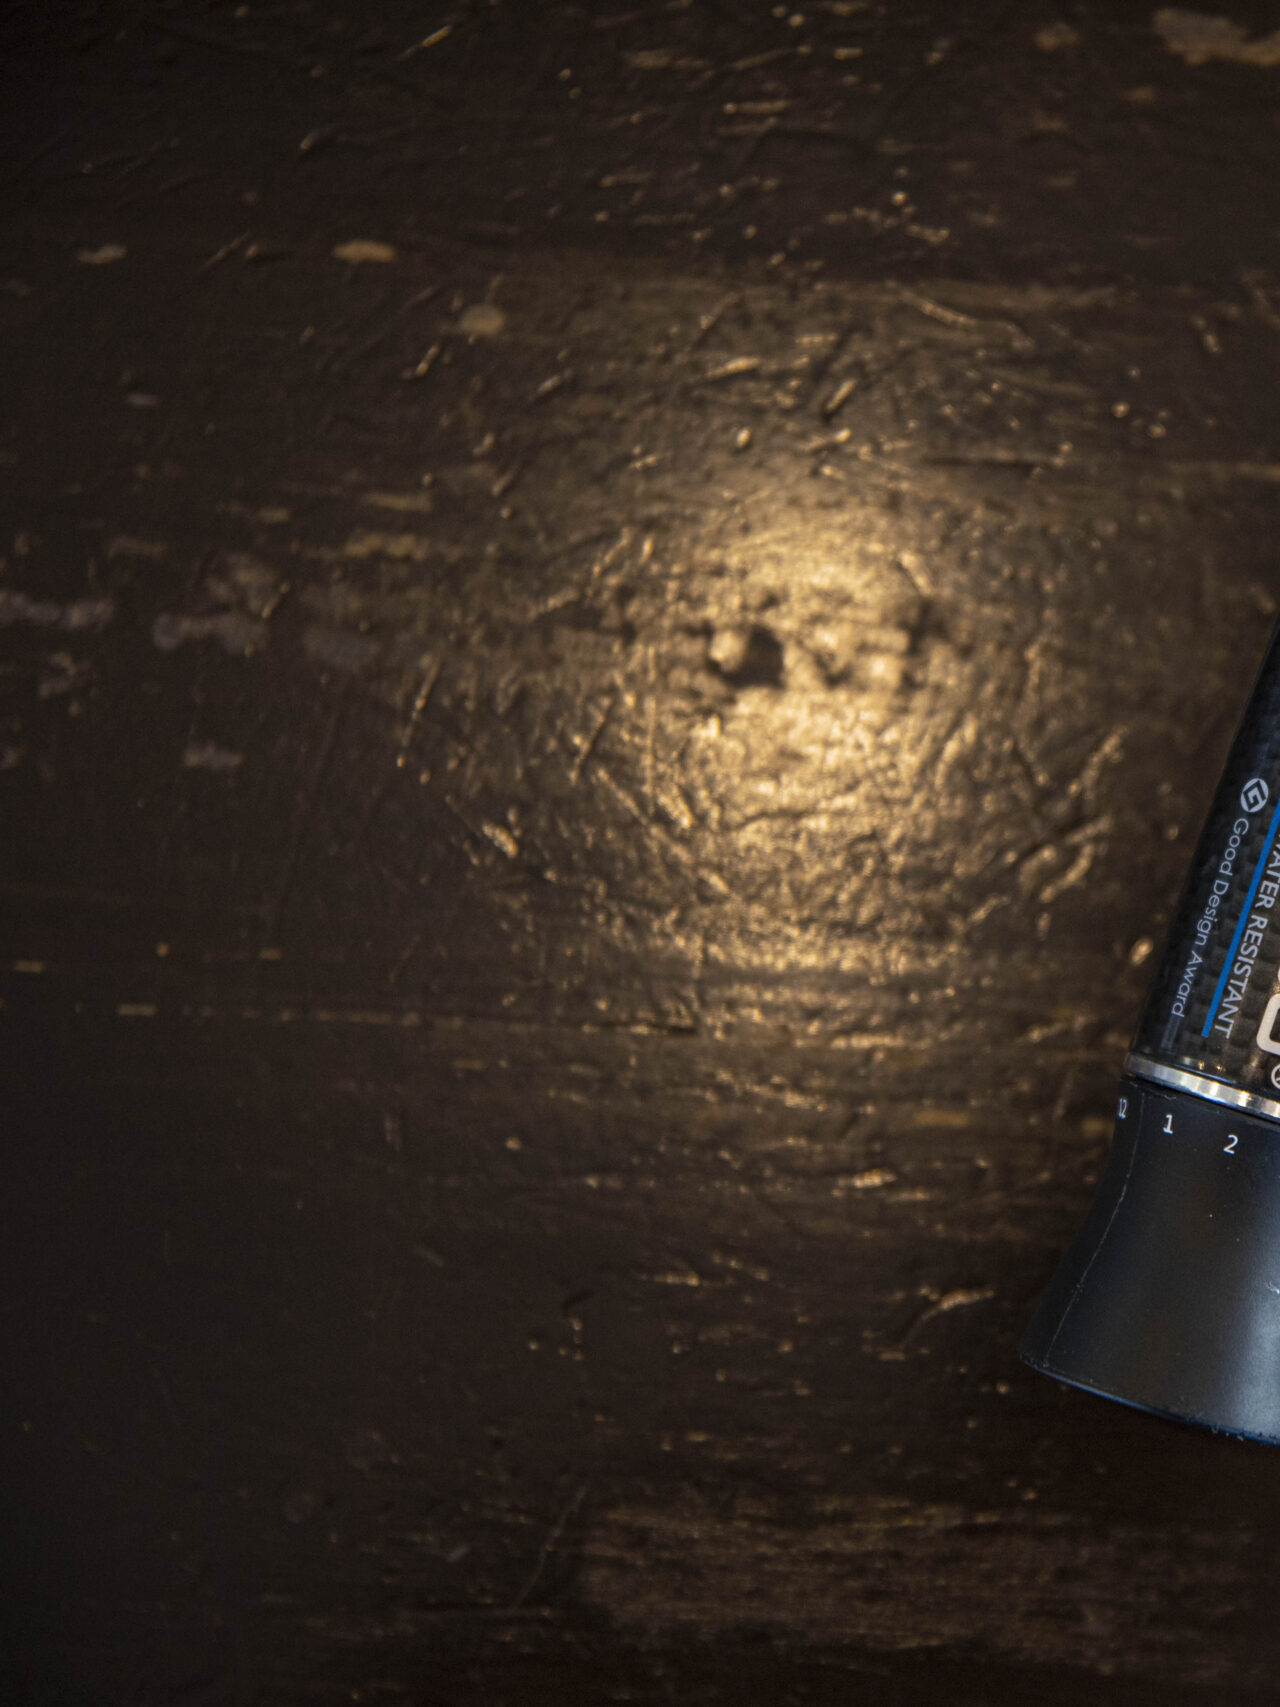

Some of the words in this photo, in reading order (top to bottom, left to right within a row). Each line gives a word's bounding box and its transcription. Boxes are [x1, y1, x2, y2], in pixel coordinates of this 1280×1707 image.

[1219, 818, 1249, 876] Good
[1195, 881, 1229, 946] Design
[1171, 951, 1203, 1017] Award
[1214, 914, 1268, 1039] RESISTANT
[1162, 1114, 1174, 1135] 1
[1223, 1134, 1239, 1154] 2
